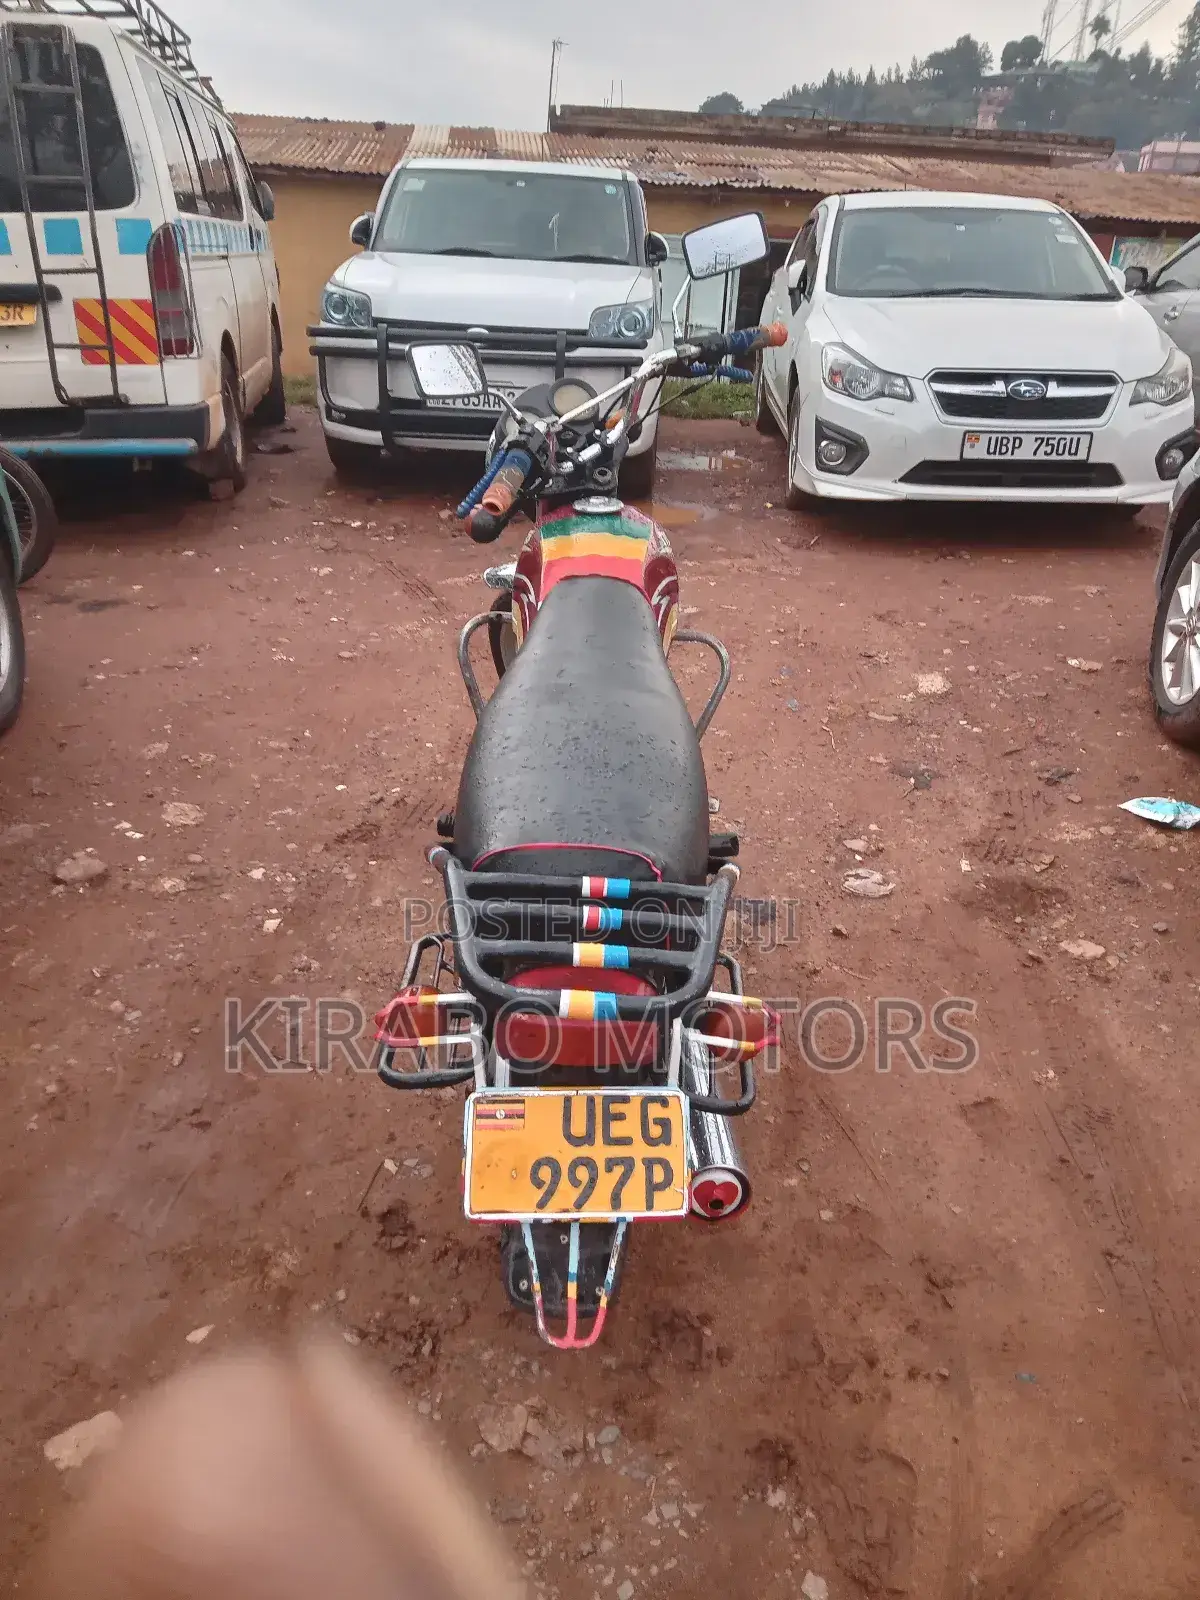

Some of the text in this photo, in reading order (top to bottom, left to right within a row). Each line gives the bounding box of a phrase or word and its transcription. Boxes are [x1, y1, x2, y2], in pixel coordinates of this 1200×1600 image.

[986, 436, 1081, 456] UBP 750U
[562, 1096, 672, 1147] UEG
[529, 1156, 674, 1211] 997P
